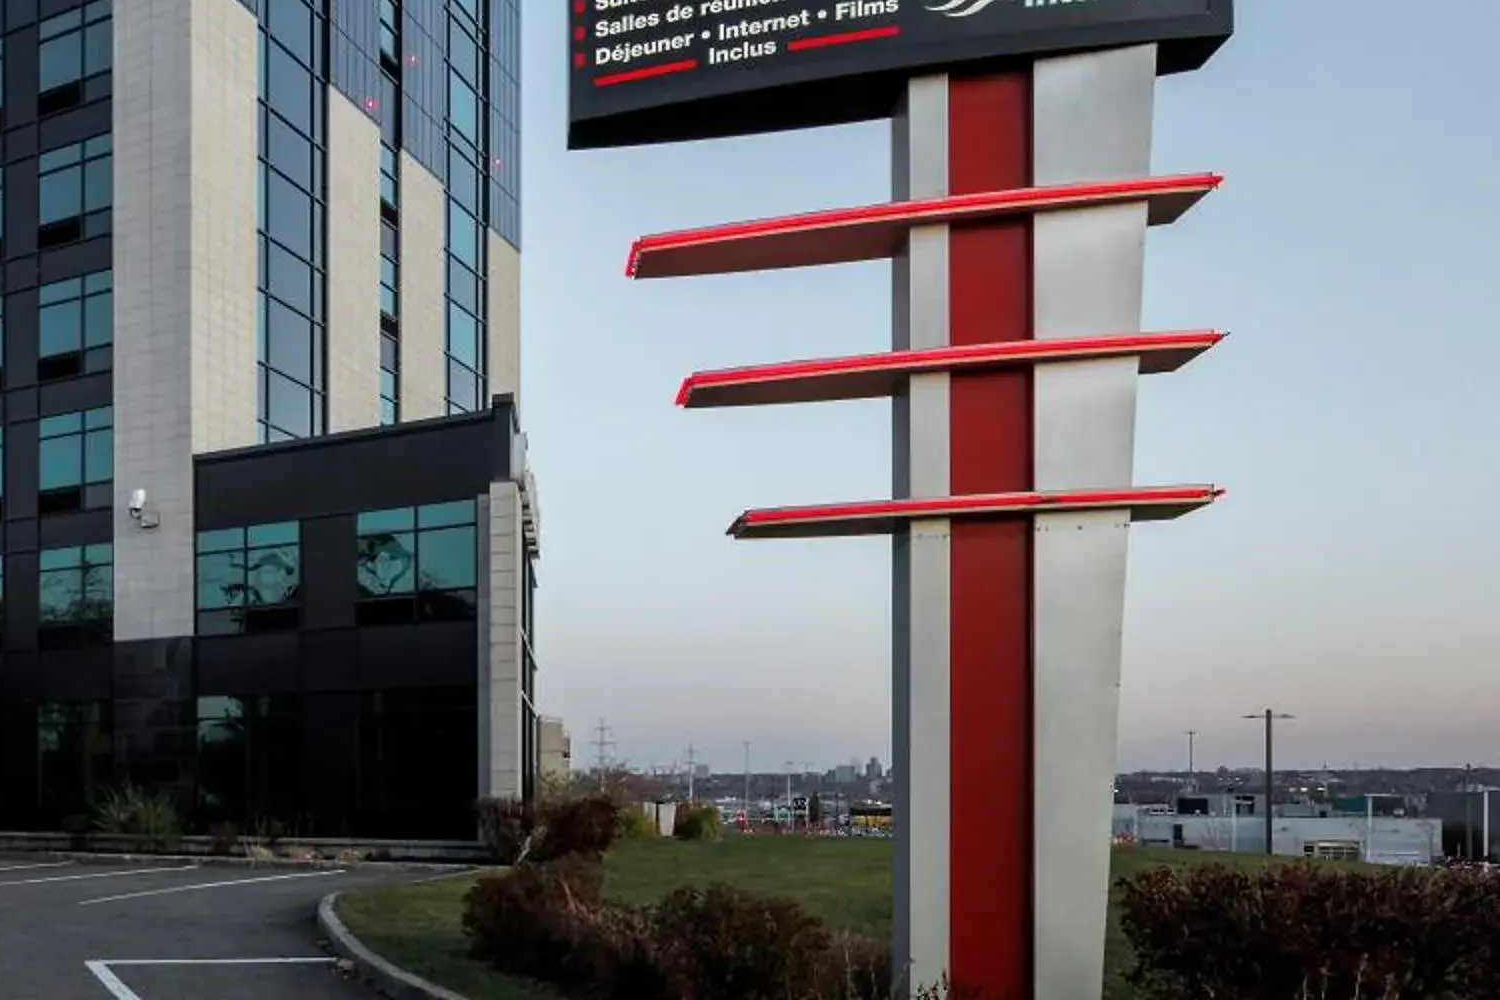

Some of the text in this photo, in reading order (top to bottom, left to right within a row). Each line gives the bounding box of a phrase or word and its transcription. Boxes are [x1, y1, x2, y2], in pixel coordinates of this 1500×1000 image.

[595, 13, 660, 37] Salles
[666, 4, 694, 22] de
[595, 32, 695, 66] Déjeuner
[718, 9, 810, 40] Internet
[708, 40, 777, 65] Inclus
